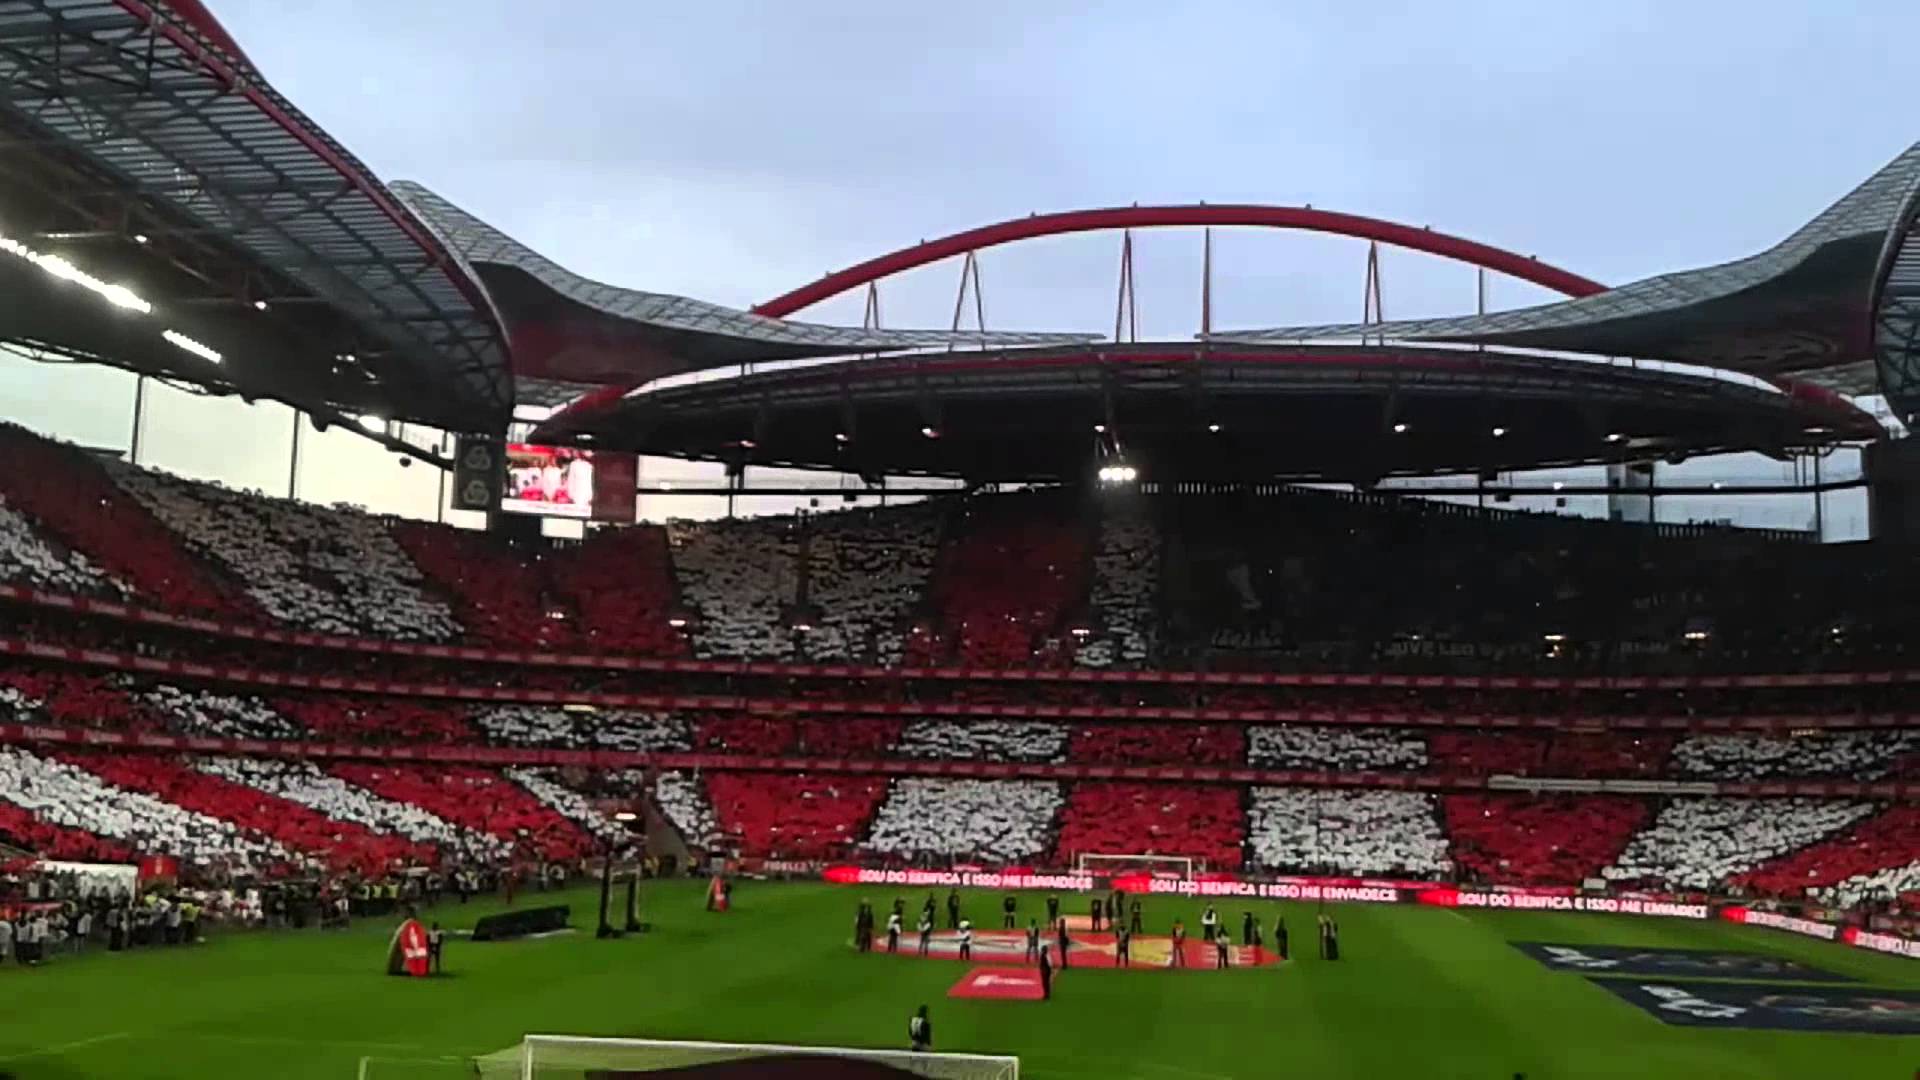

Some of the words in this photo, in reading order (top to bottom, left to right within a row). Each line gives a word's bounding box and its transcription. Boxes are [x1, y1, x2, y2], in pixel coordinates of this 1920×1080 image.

[858, 869, 885, 882] SOU
[887, 870, 906, 883] DO
[1150, 879, 1176, 892] SOU
[1200, 881, 1256, 895] BENFICA
[1457, 893, 1486, 905] SOU
[1490, 894, 1512, 907] DO
[1575, 897, 1584, 910] E
[1587, 898, 1615, 911] ISSO
